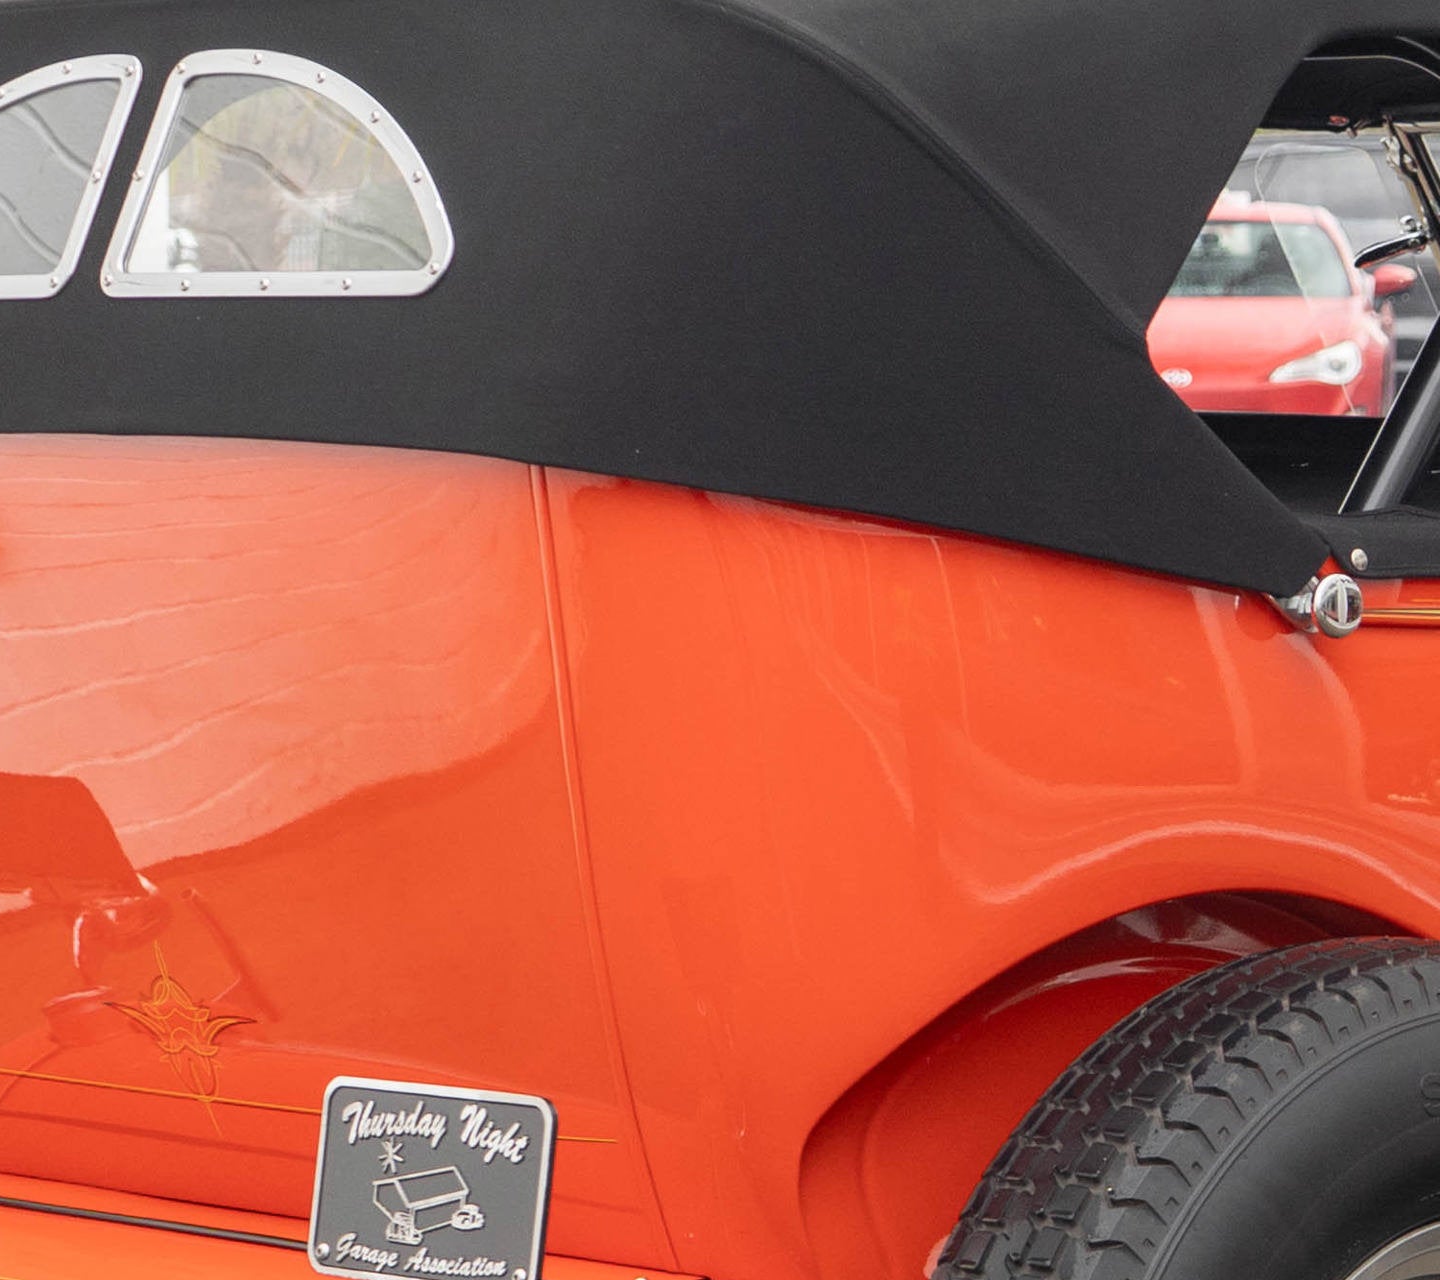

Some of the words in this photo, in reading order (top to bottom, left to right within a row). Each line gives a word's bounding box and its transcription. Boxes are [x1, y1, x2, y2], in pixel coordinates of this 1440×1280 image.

[342, 1101, 448, 1149] Thursday
[459, 1103, 531, 1165] Night
[335, 1232, 399, 1269] Garage
[403, 1246, 509, 1278] Association
